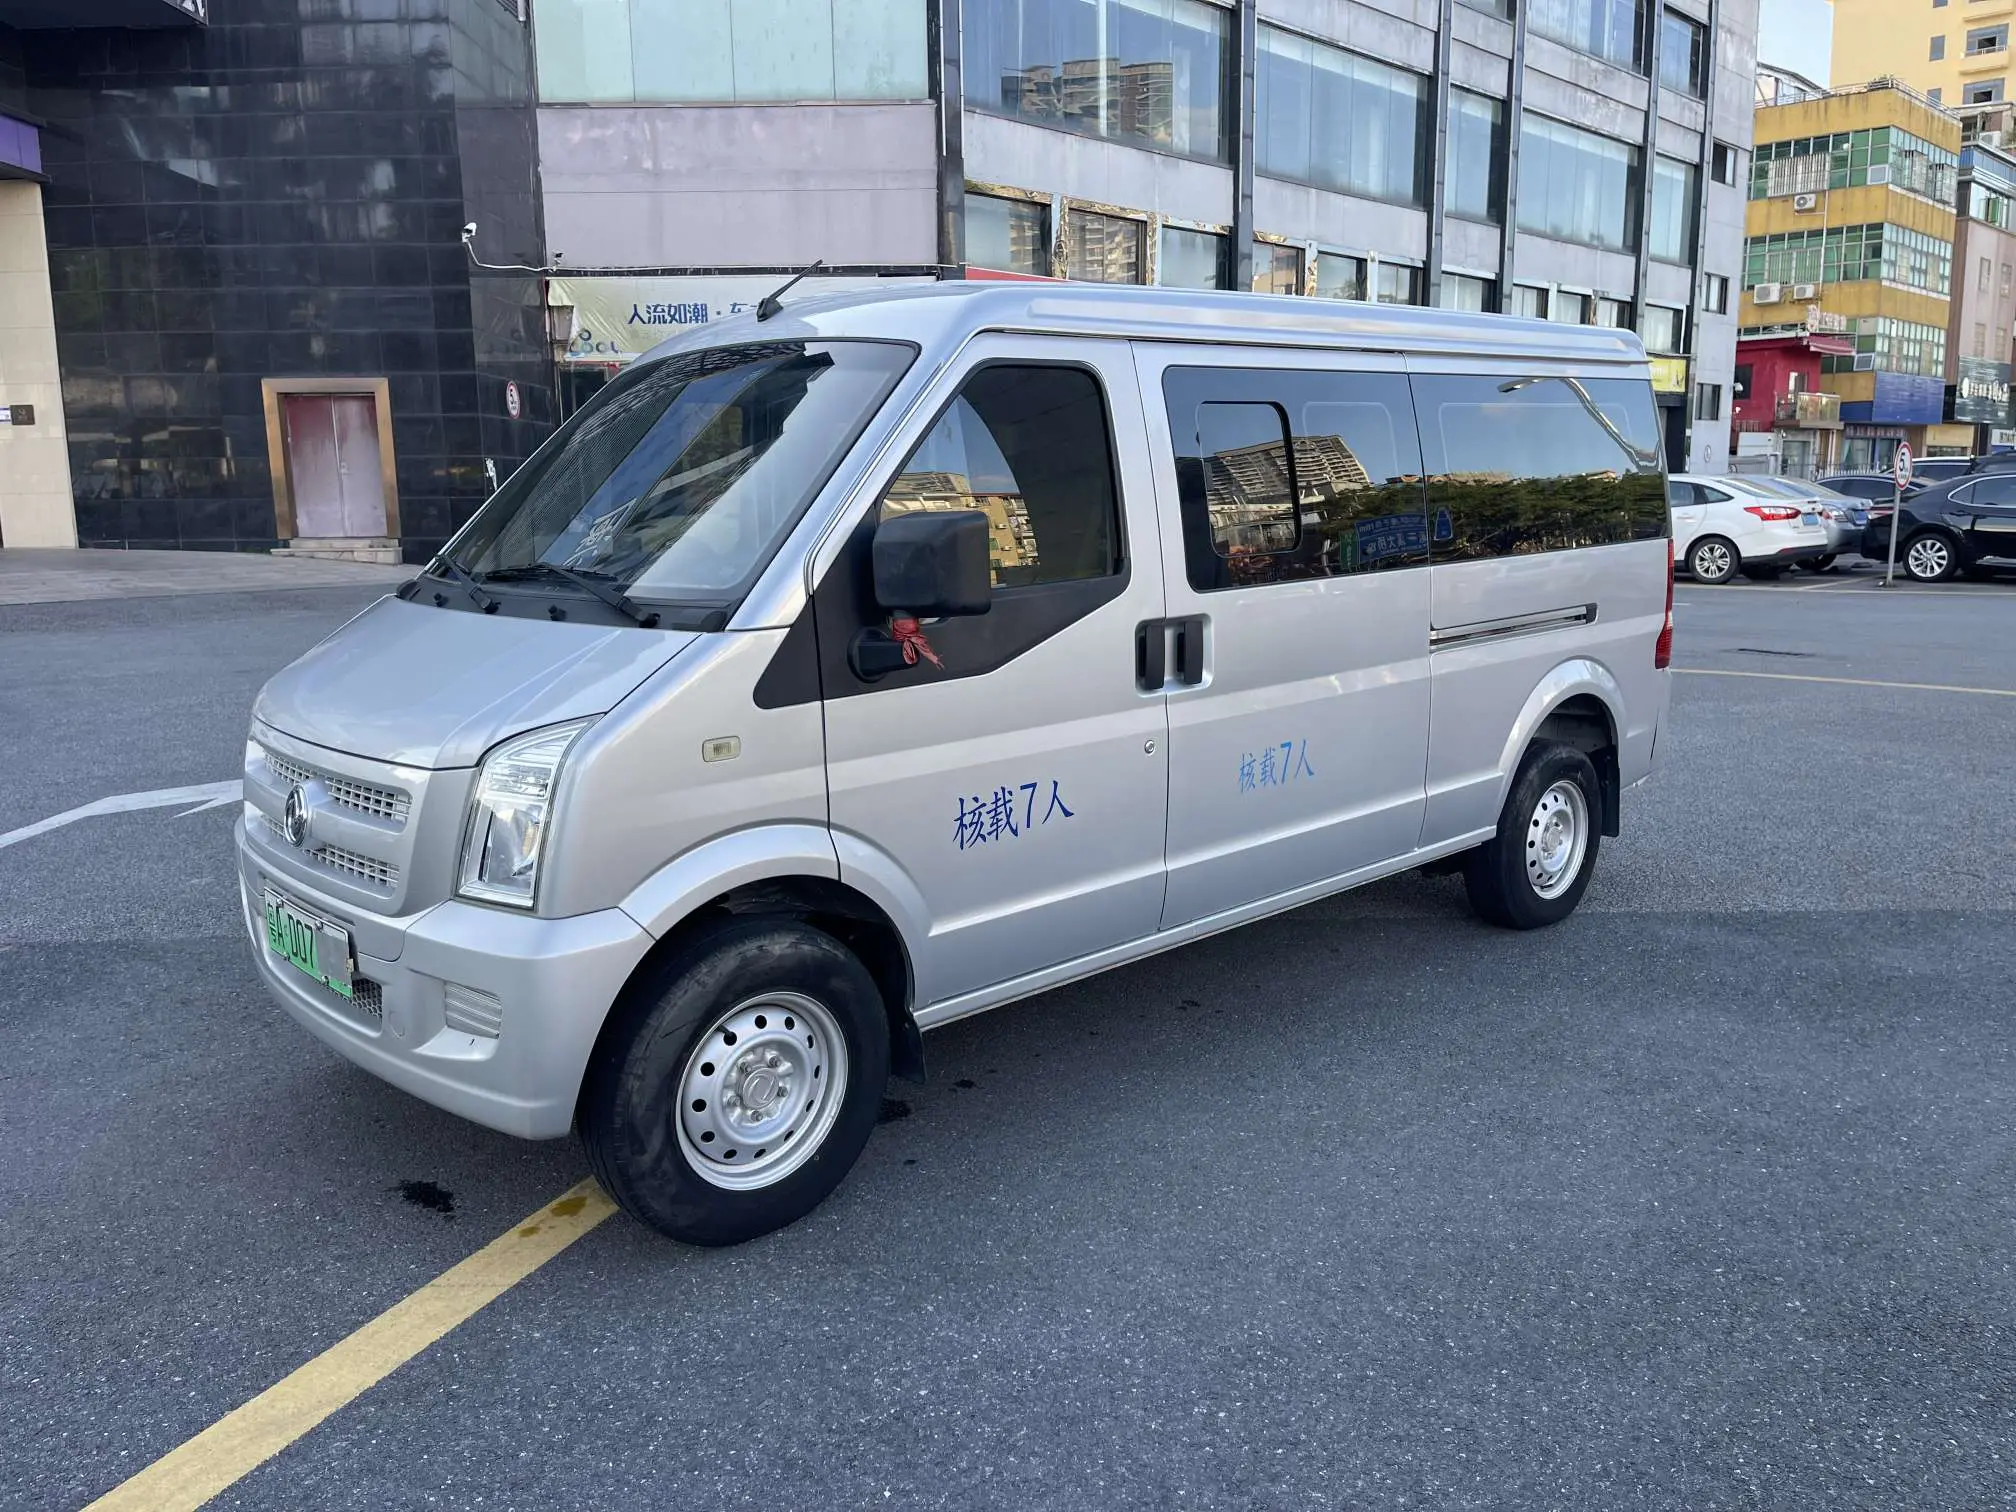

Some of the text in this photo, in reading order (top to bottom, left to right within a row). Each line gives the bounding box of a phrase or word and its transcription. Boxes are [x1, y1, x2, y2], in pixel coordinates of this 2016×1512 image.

[1238, 739, 1315, 794] 核载7人
[952, 779, 1075, 851] 核载7人
